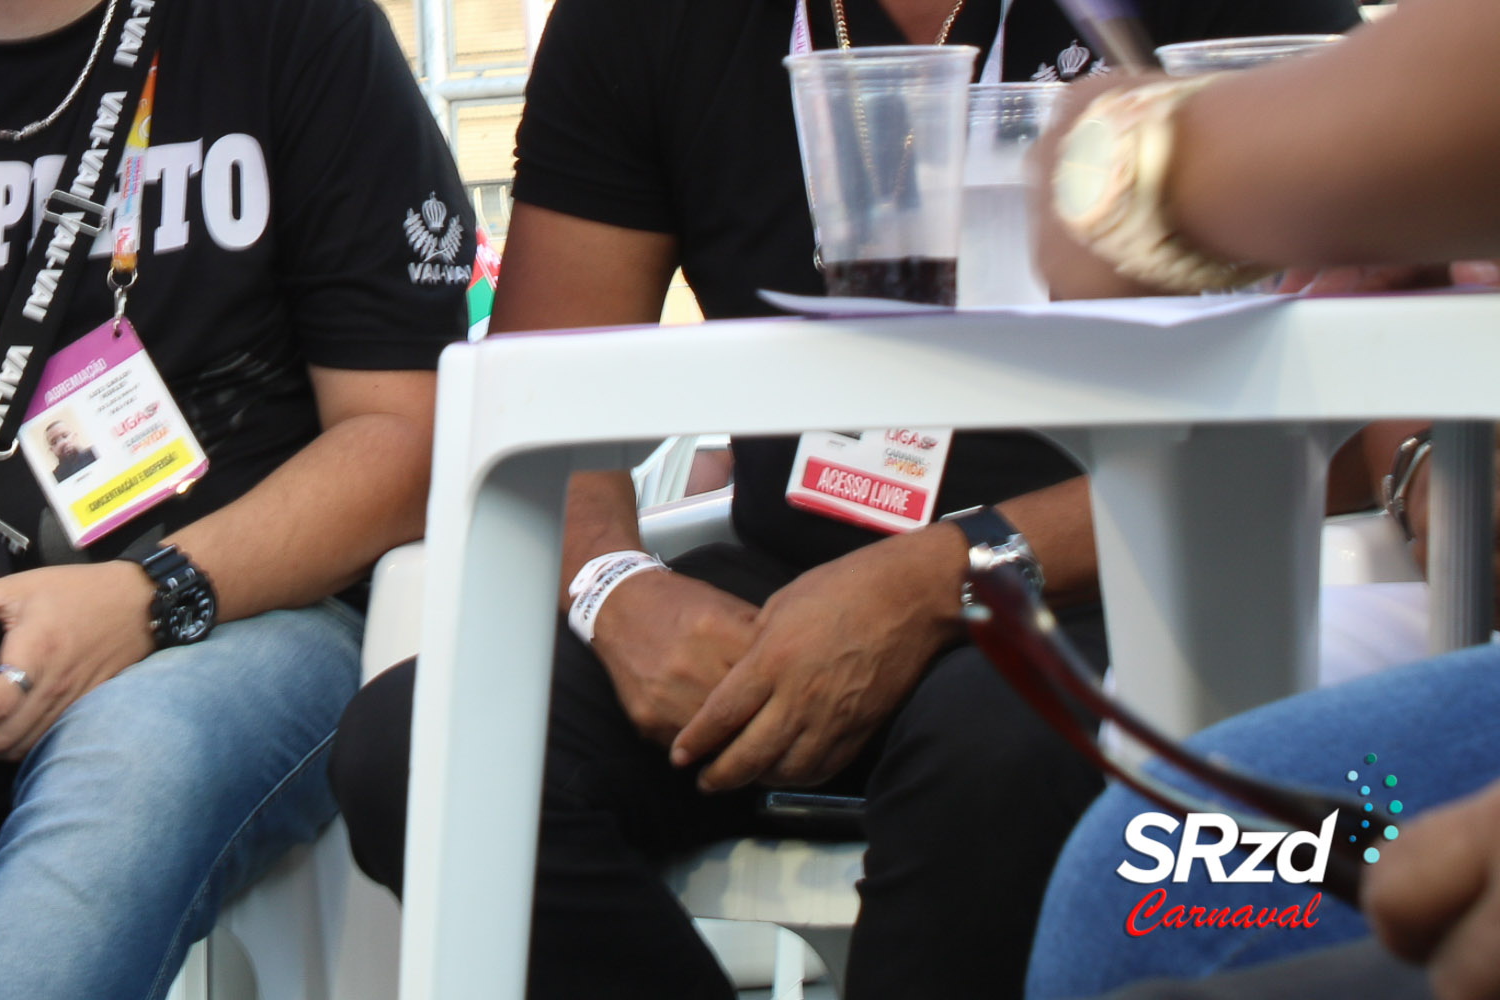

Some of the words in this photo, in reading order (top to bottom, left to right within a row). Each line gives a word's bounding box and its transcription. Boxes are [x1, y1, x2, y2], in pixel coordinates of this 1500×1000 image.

[69, 91, 127, 200] VAI-VAI
[22, 211, 86, 323] VAI-VAI
[408, 262, 472, 285] VAI-VAI
[44, 358, 108, 407] AGREMIAÇÃO
[817, 467, 872, 504] ACESSO
[868, 482, 913, 514] LIVRE
